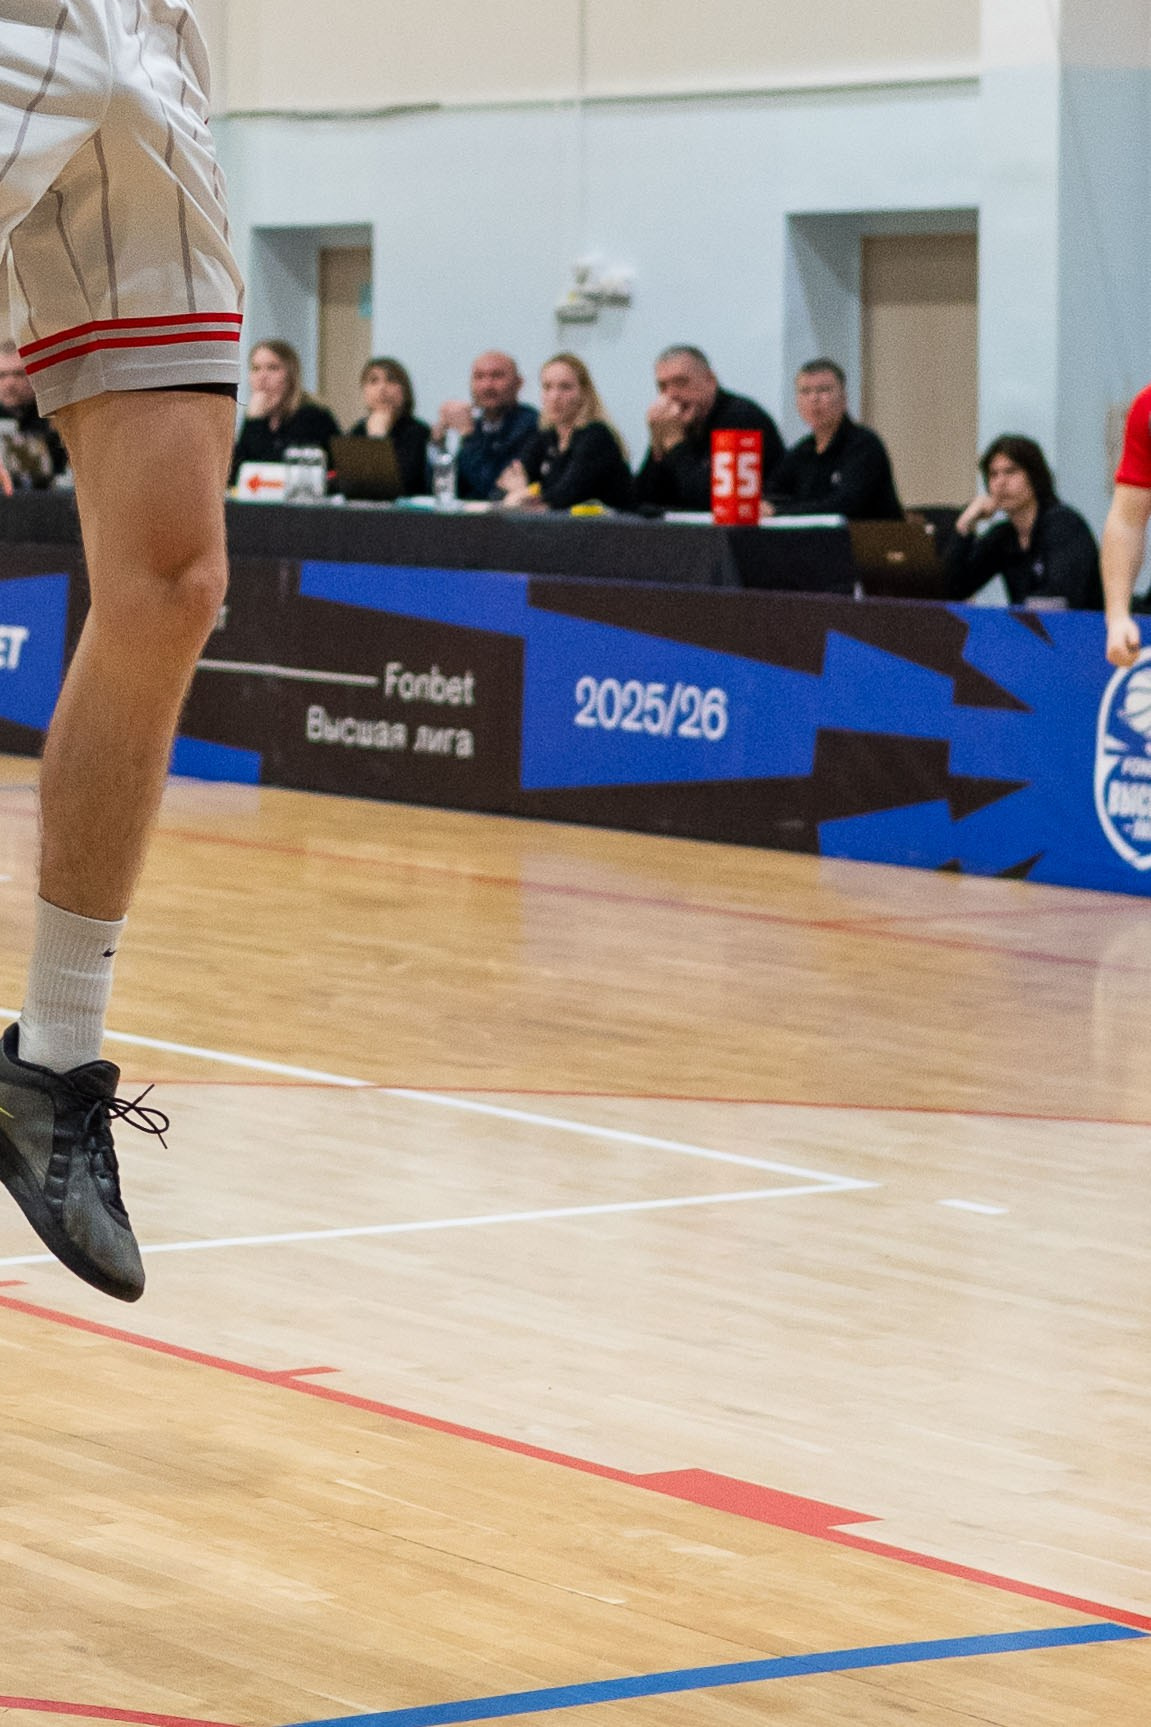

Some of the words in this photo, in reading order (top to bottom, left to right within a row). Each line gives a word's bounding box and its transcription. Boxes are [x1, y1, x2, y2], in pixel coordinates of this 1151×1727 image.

[712, 452, 760, 498] 55
[384, 661, 476, 706] Fonbet
[574, 675, 728, 742] 2025/26
[306, 704, 408, 748] Высшая
[413, 724, 475, 759] лига
